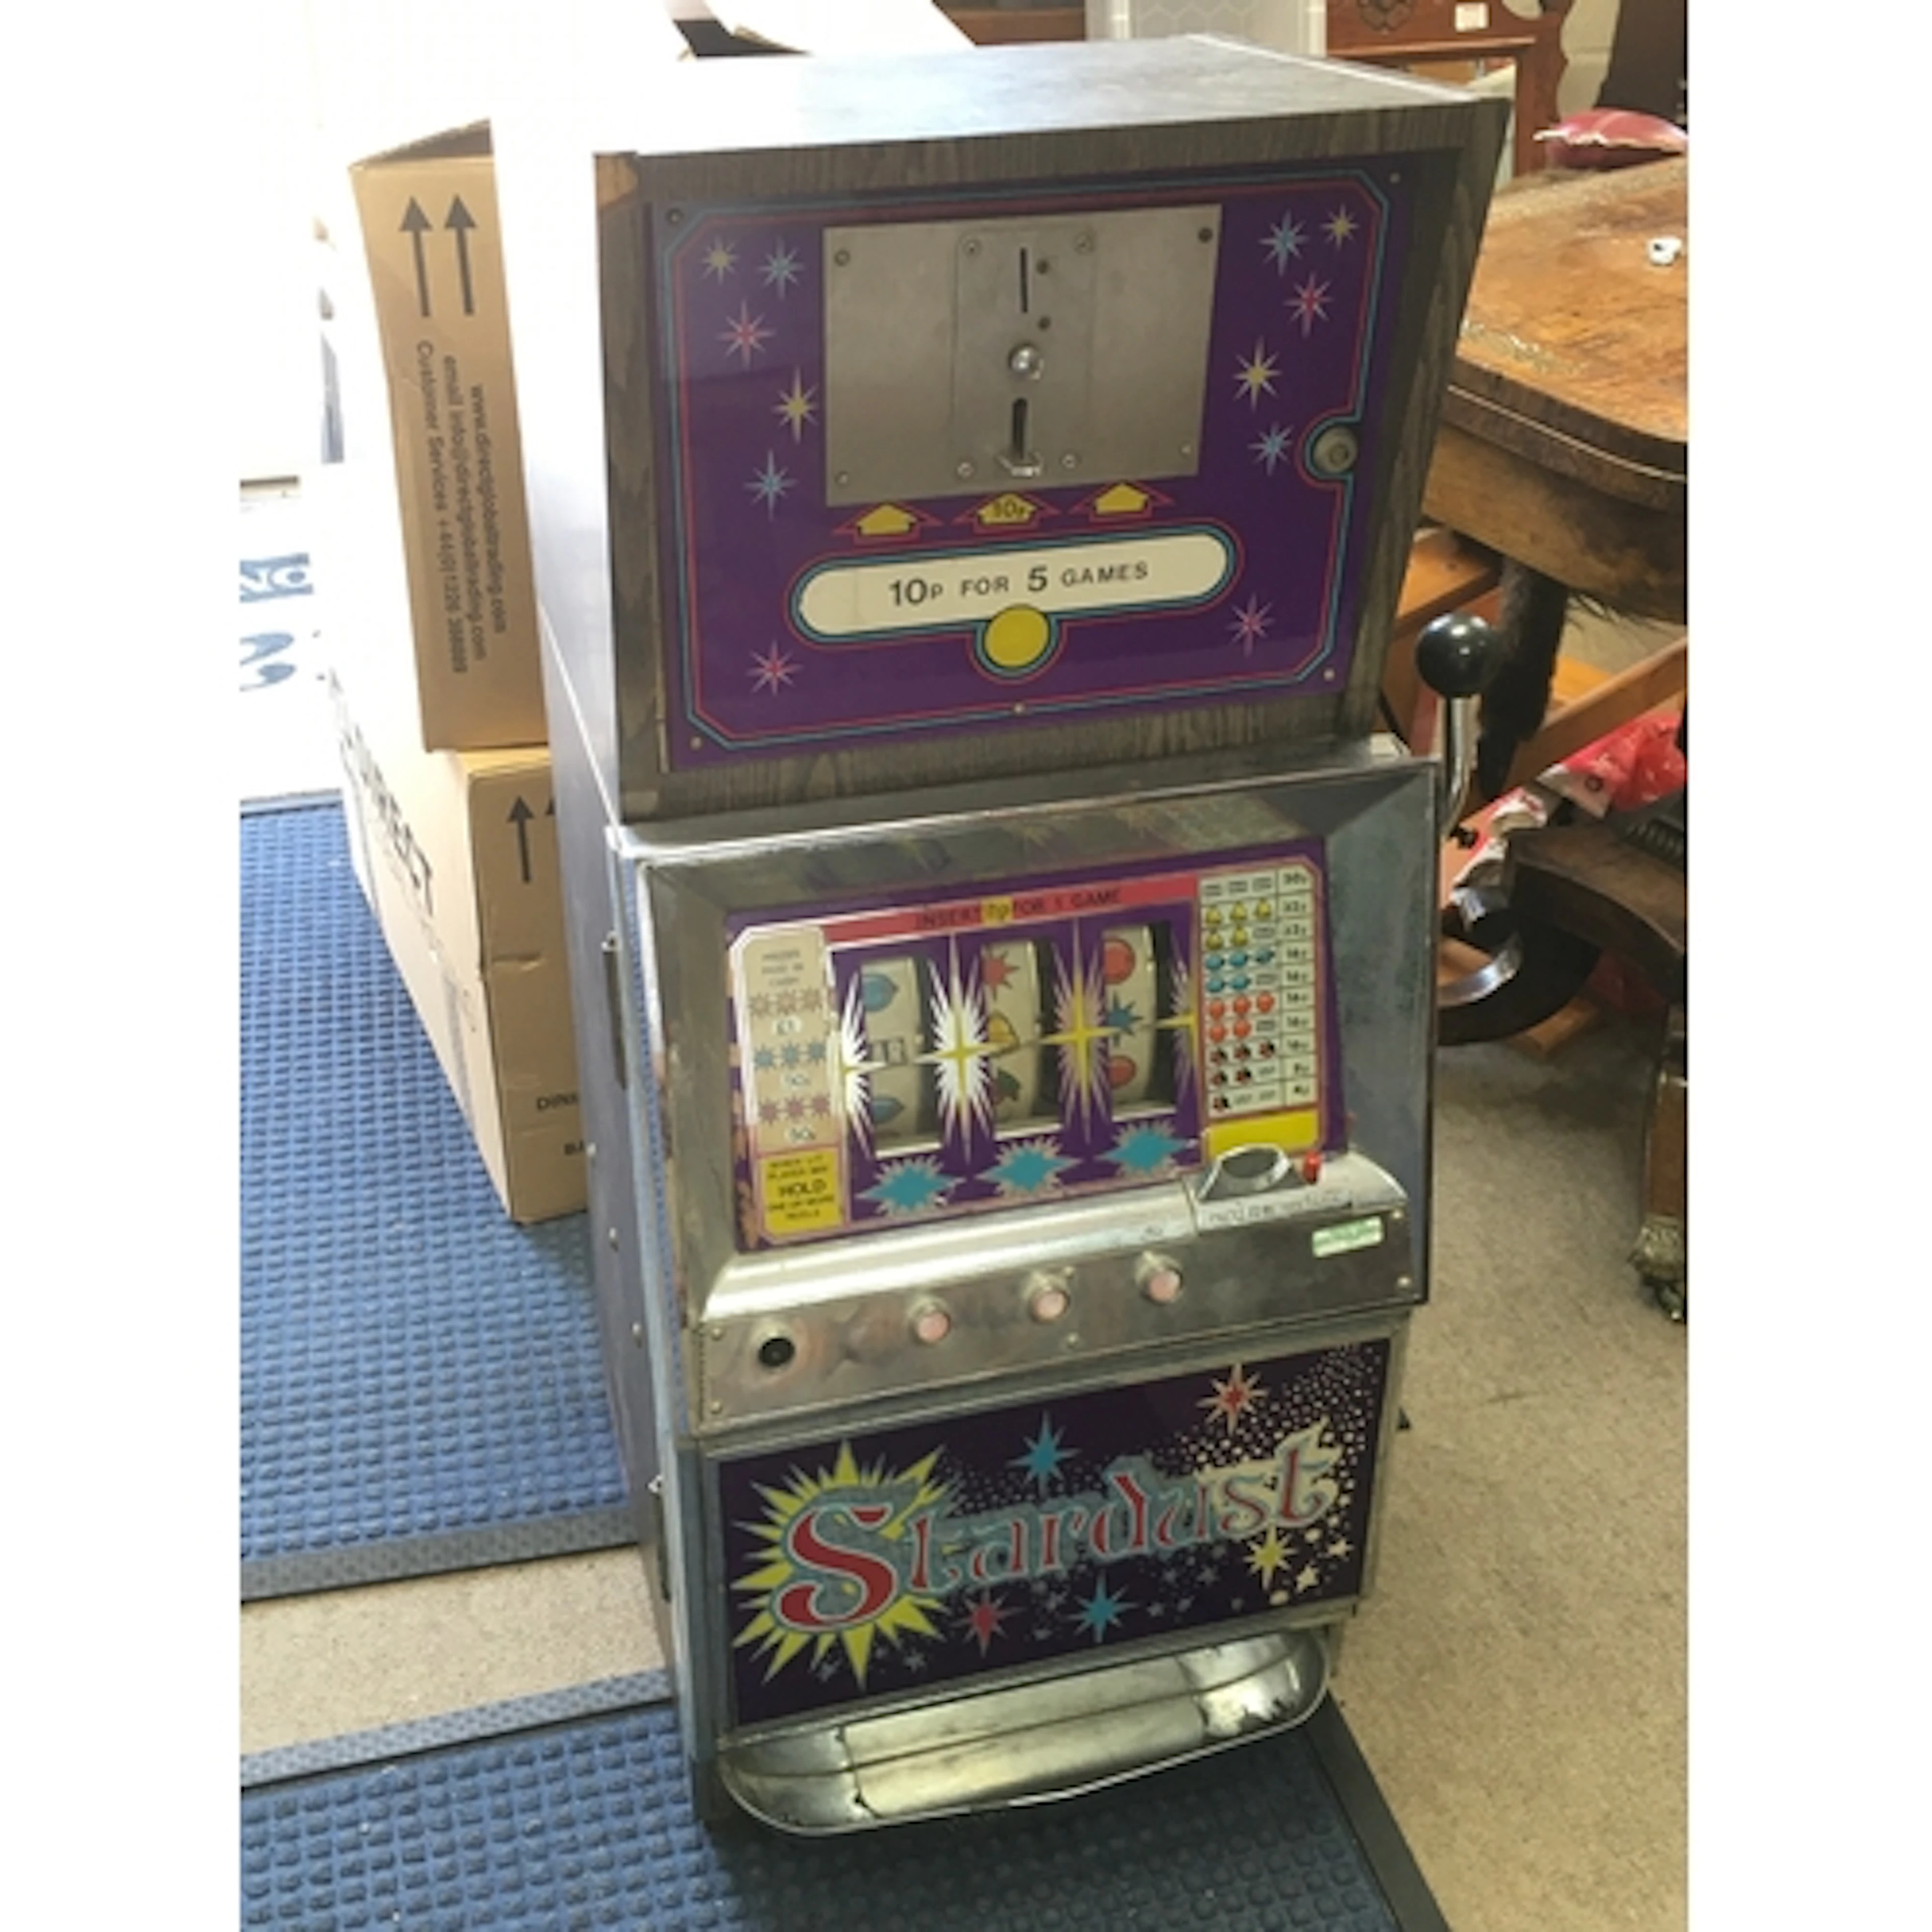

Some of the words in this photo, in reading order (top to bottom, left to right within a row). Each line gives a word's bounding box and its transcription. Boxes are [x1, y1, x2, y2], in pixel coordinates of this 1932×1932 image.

[417, 340, 439, 430] Customer
[428, 436, 449, 511] Services
[960, 576, 1010, 597] FOR
[1027, 564, 1049, 593] 5
[1061, 560, 1149, 588] GAMES
[770, 1438, 1339, 1633] Stardust
